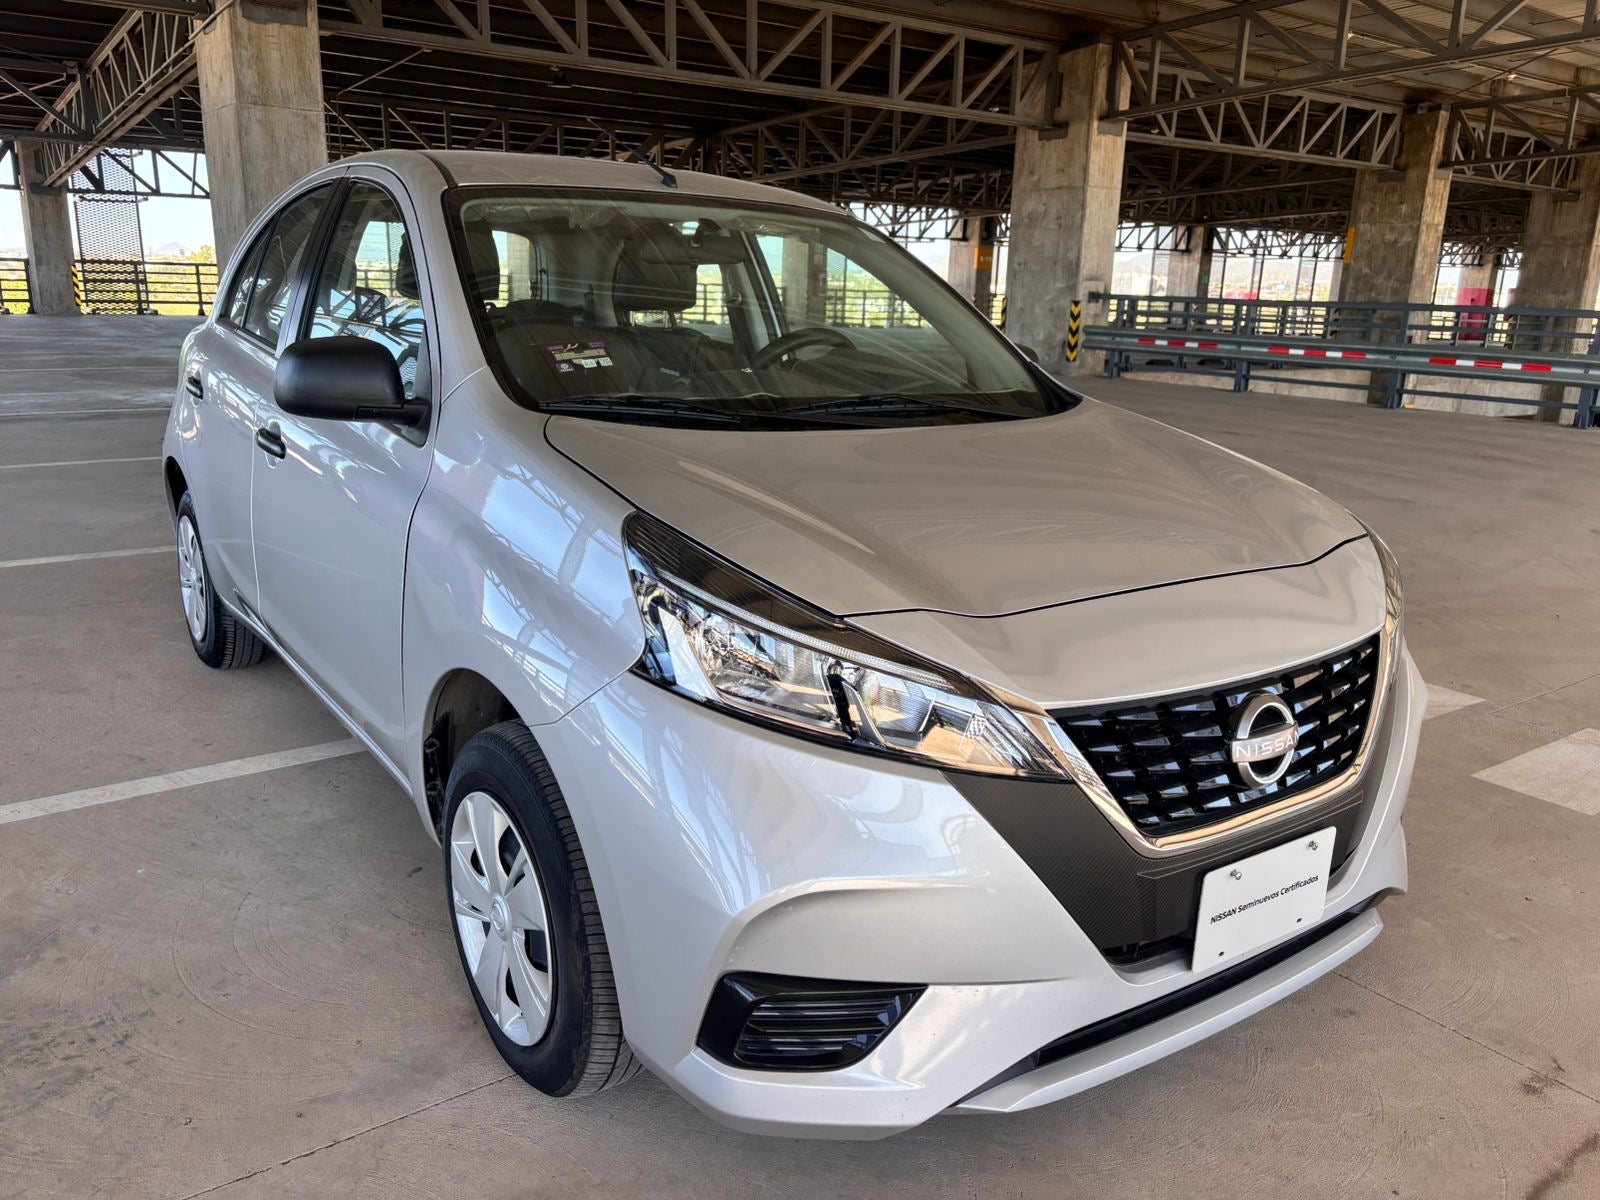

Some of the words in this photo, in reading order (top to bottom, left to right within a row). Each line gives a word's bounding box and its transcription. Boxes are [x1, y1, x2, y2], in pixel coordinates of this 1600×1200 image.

[1235, 731, 1299, 758] NISSAN
[1210, 908, 1237, 924] NISSAN
[1237, 891, 1279, 913] Seminuevos
[1280, 874, 1319, 896] Certificados
